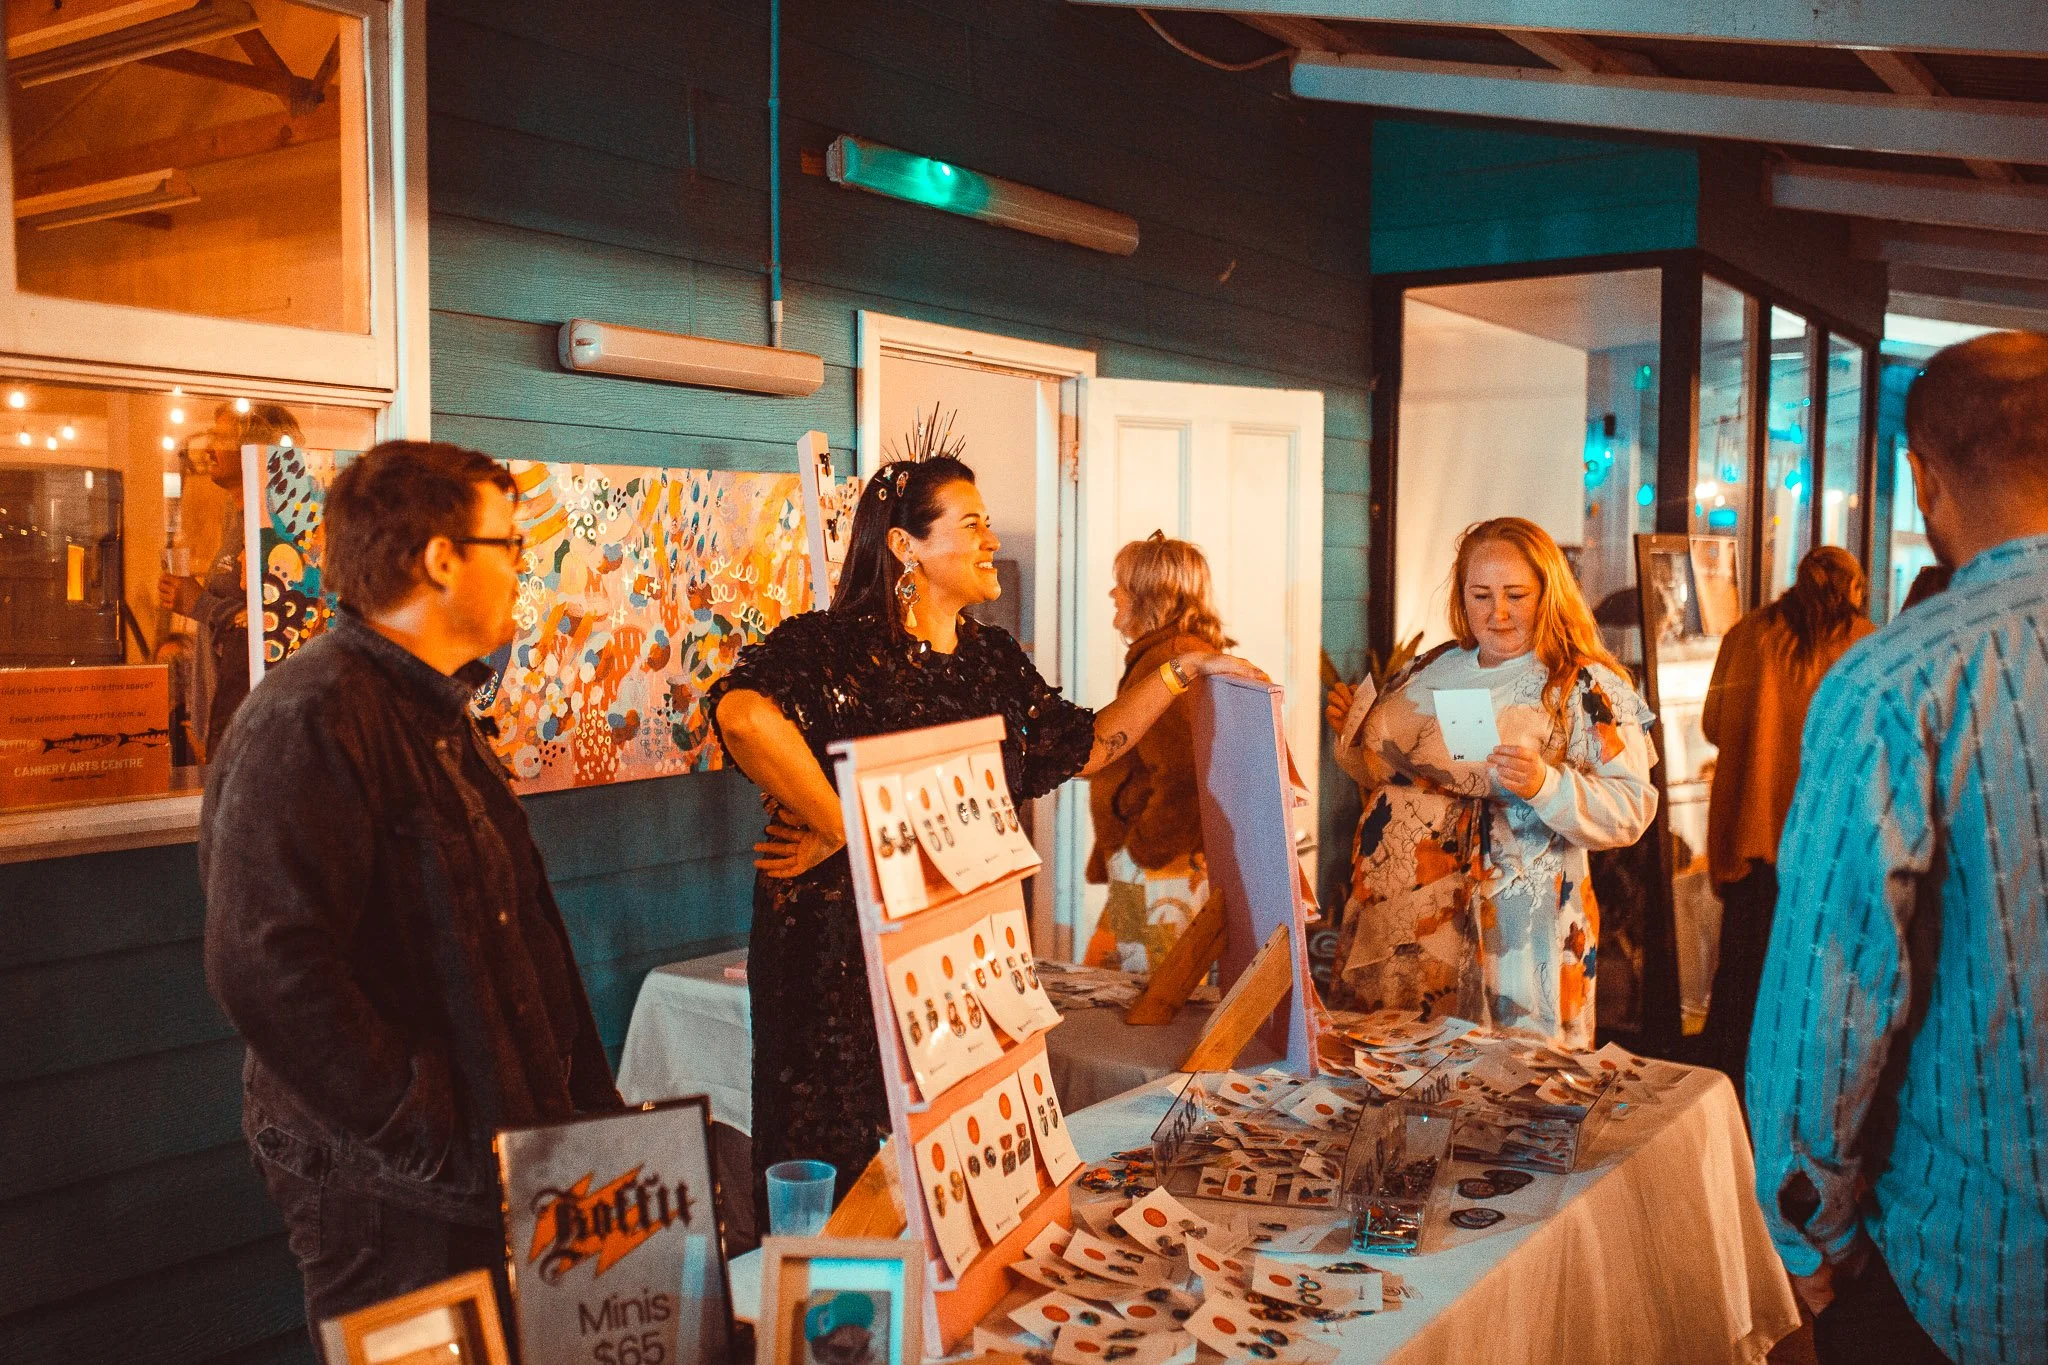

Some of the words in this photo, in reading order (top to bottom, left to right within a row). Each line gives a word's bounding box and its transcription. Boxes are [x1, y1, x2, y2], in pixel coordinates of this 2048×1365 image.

[75, 684, 89, 692] can
[13, 763, 66, 778] CANNERY
[68, 760, 99, 773] ARTS
[101, 757, 144, 770] CENTRE
[577, 1288, 671, 1337] Minis
[593, 1332, 666, 1365] $65
